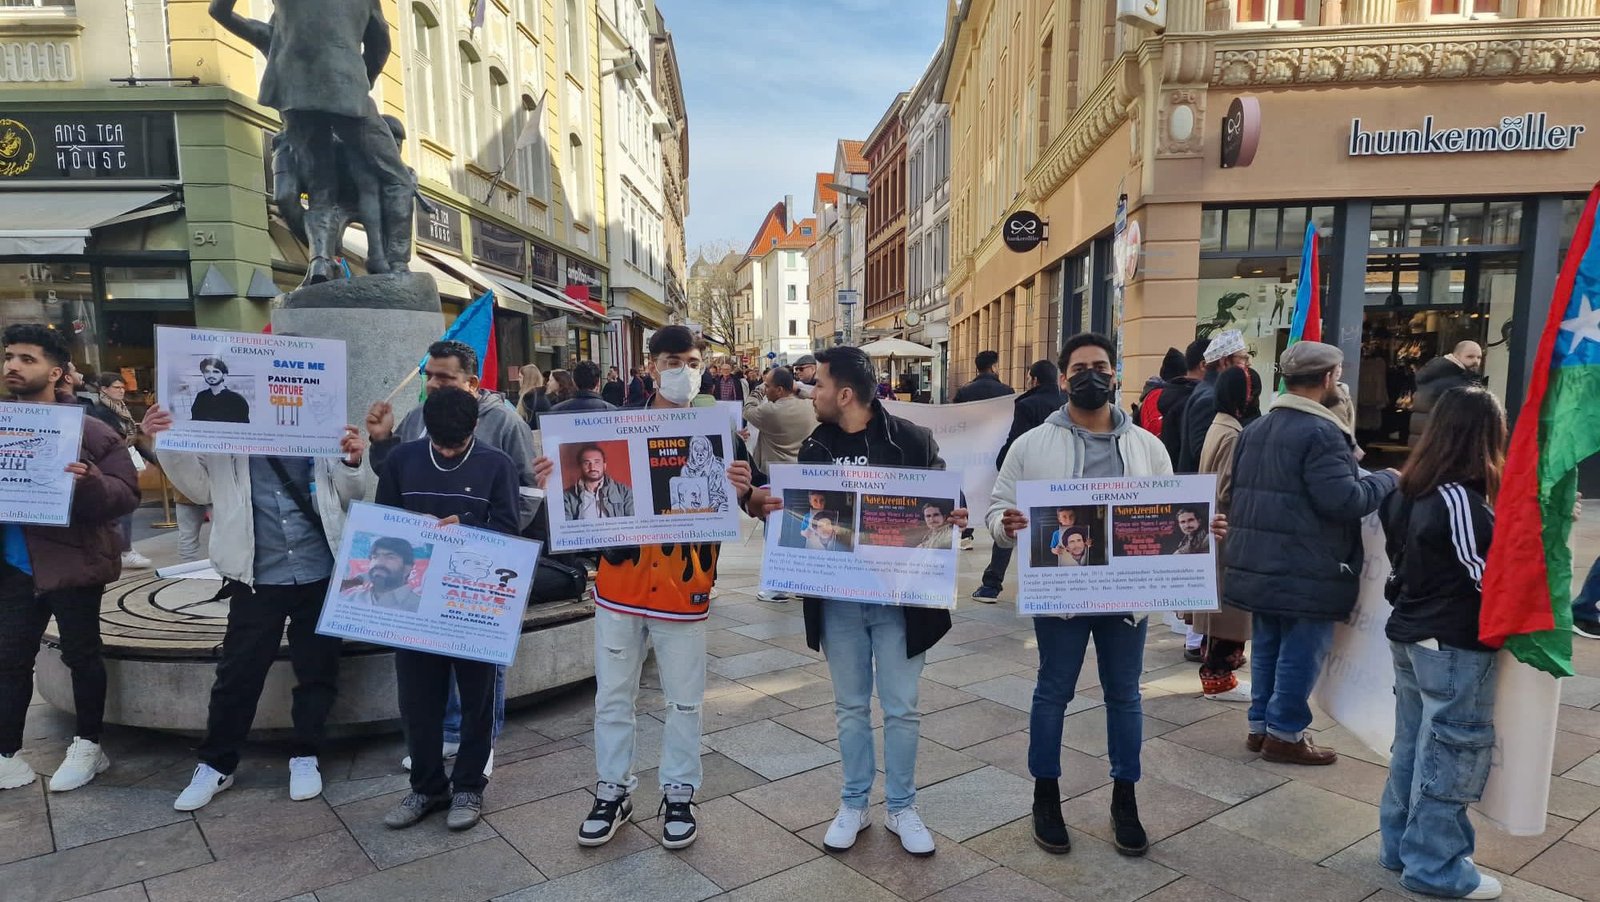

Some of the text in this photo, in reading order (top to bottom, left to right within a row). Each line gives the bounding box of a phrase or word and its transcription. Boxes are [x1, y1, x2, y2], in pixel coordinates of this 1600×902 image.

[55, 124, 124, 142] AN'S TEA
[1349, 112, 1586, 156] hunkemöller
[56, 151, 127, 170] HOUSE
[193, 231, 218, 246] 54
[190, 333, 315, 349] BALOCH REPUBLICAN PARTY
[230, 346, 276, 356] GERMANY
[273, 359, 326, 371] SAVE ME
[267, 375, 320, 385] PAKISTANI
[268, 383, 304, 396] TORTURE
[25, 407, 52, 416] PARTY
[575, 412, 698, 427] BALOCH REPUBLICAN PARTY
[616, 425, 660, 435] GERMANY
[649, 438, 686, 449] BRING
[658, 448, 679, 457] HIM
[650, 456, 688, 468] BACK
[802, 468, 927, 482] BALOCH REPUBLICAN PARTY
[841, 480, 887, 490] GERMANY
[1050, 479, 1182, 492] BALOCH REPUBLICAN PARTY
[1091, 492, 1139, 501] GERMANY
[383, 513, 421, 527] BALOCH
[480, 534, 507, 547] PARTY
[420, 530, 467, 546] GERMANY
[442, 576, 517, 594] PAKISTAN
[447, 589, 506, 604] ALIVE
[440, 613, 500, 627] MOHAMMAD
[467, 612, 495, 620] DEEN
